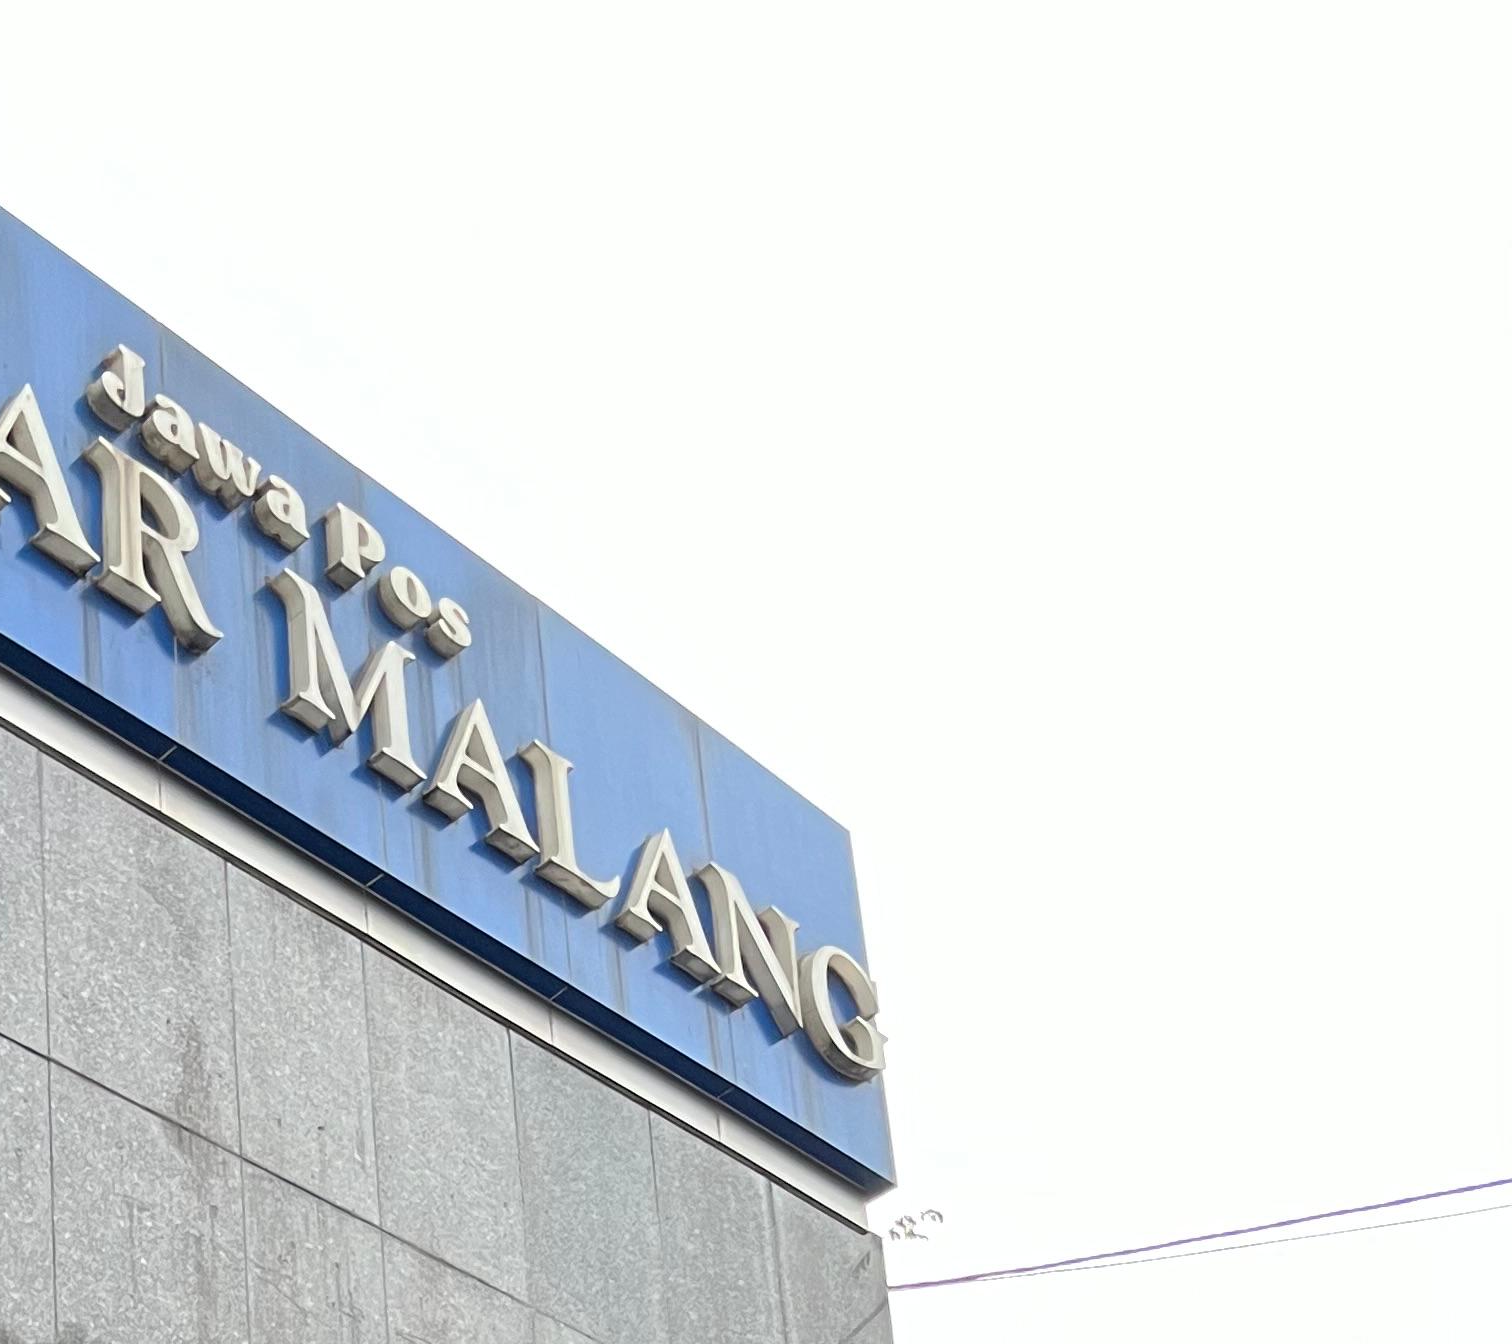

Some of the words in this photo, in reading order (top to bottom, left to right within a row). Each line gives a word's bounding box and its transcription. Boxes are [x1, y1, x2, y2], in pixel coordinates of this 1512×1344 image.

[89, 343, 310, 552] Jawa
[324, 502, 473, 660] Pos
[268, 567, 888, 1084] MALANG
